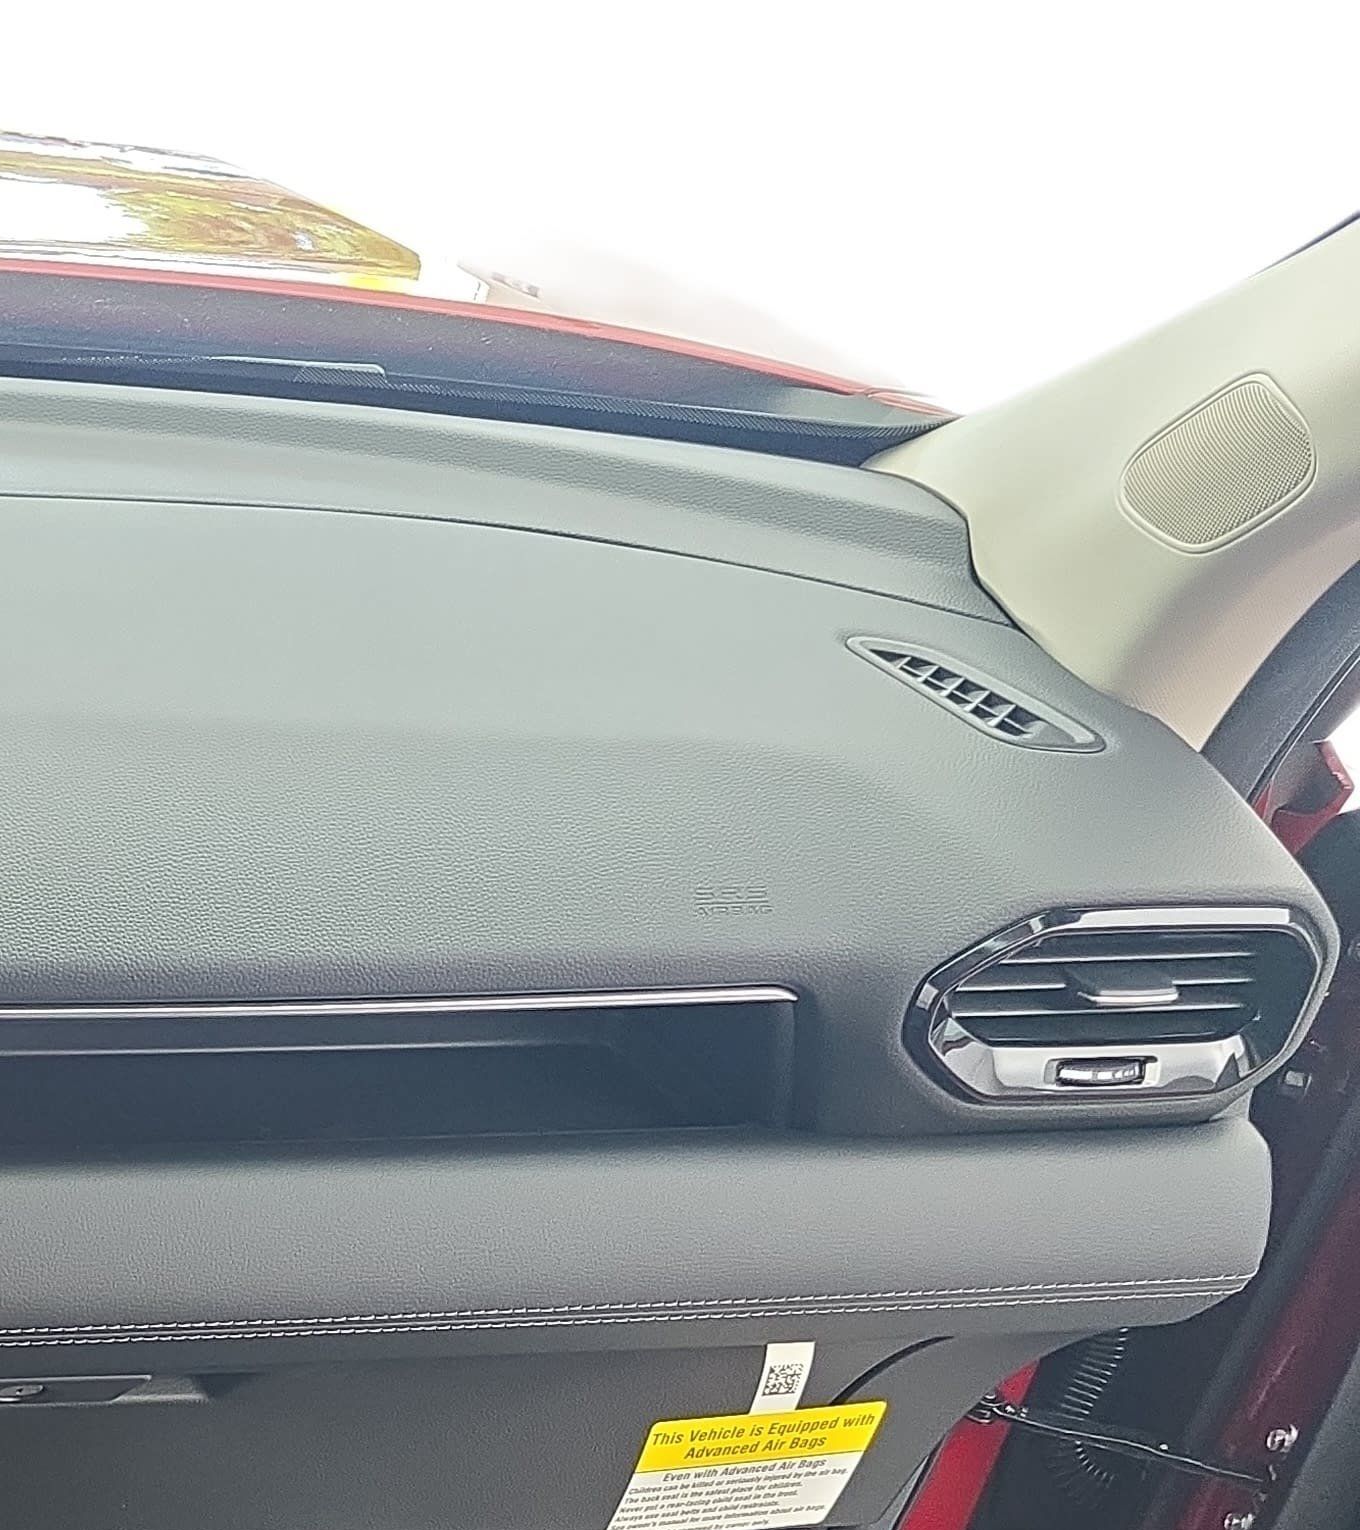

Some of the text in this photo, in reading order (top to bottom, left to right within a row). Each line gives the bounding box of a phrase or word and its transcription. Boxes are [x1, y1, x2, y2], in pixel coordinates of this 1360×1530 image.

[653, 1414, 874, 1445] This Vehicle is Equipped with
[684, 1436, 826, 1458] Advanced Air Bags
[662, 1459, 826, 1482] Even with Advanced Air Bags
